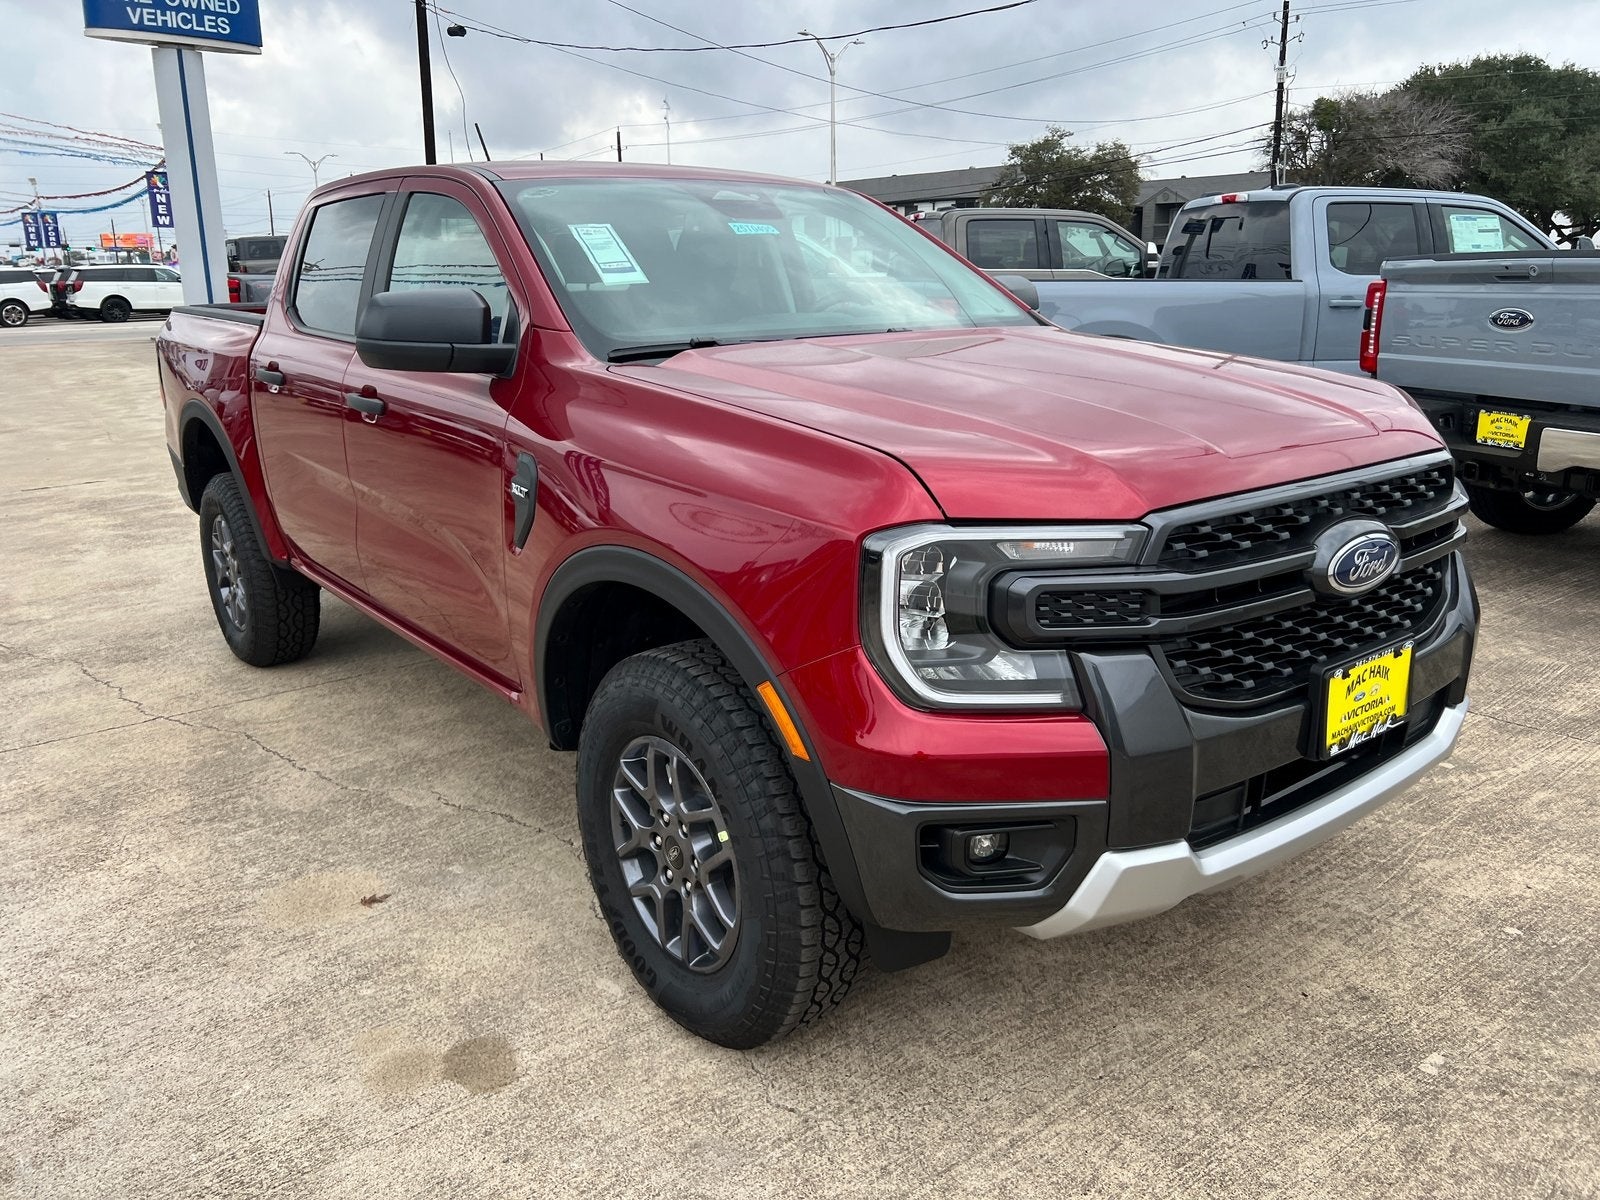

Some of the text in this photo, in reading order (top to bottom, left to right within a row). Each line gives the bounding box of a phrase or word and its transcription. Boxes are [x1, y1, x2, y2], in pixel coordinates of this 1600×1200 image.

[126, 6, 231, 34] VEHICLES
[155, 192, 170, 225] NEW
[27, 226, 39, 246] NEW
[1497, 311, 1522, 326] Ford
[1391, 334, 1519, 353] SUPER
[511, 482, 529, 498] XLT
[1349, 546, 1388, 581] Ford
[1345, 668, 1368, 700] MAC
[1368, 664, 1391, 681] HAIK
[1347, 696, 1384, 721] VICTORIA
